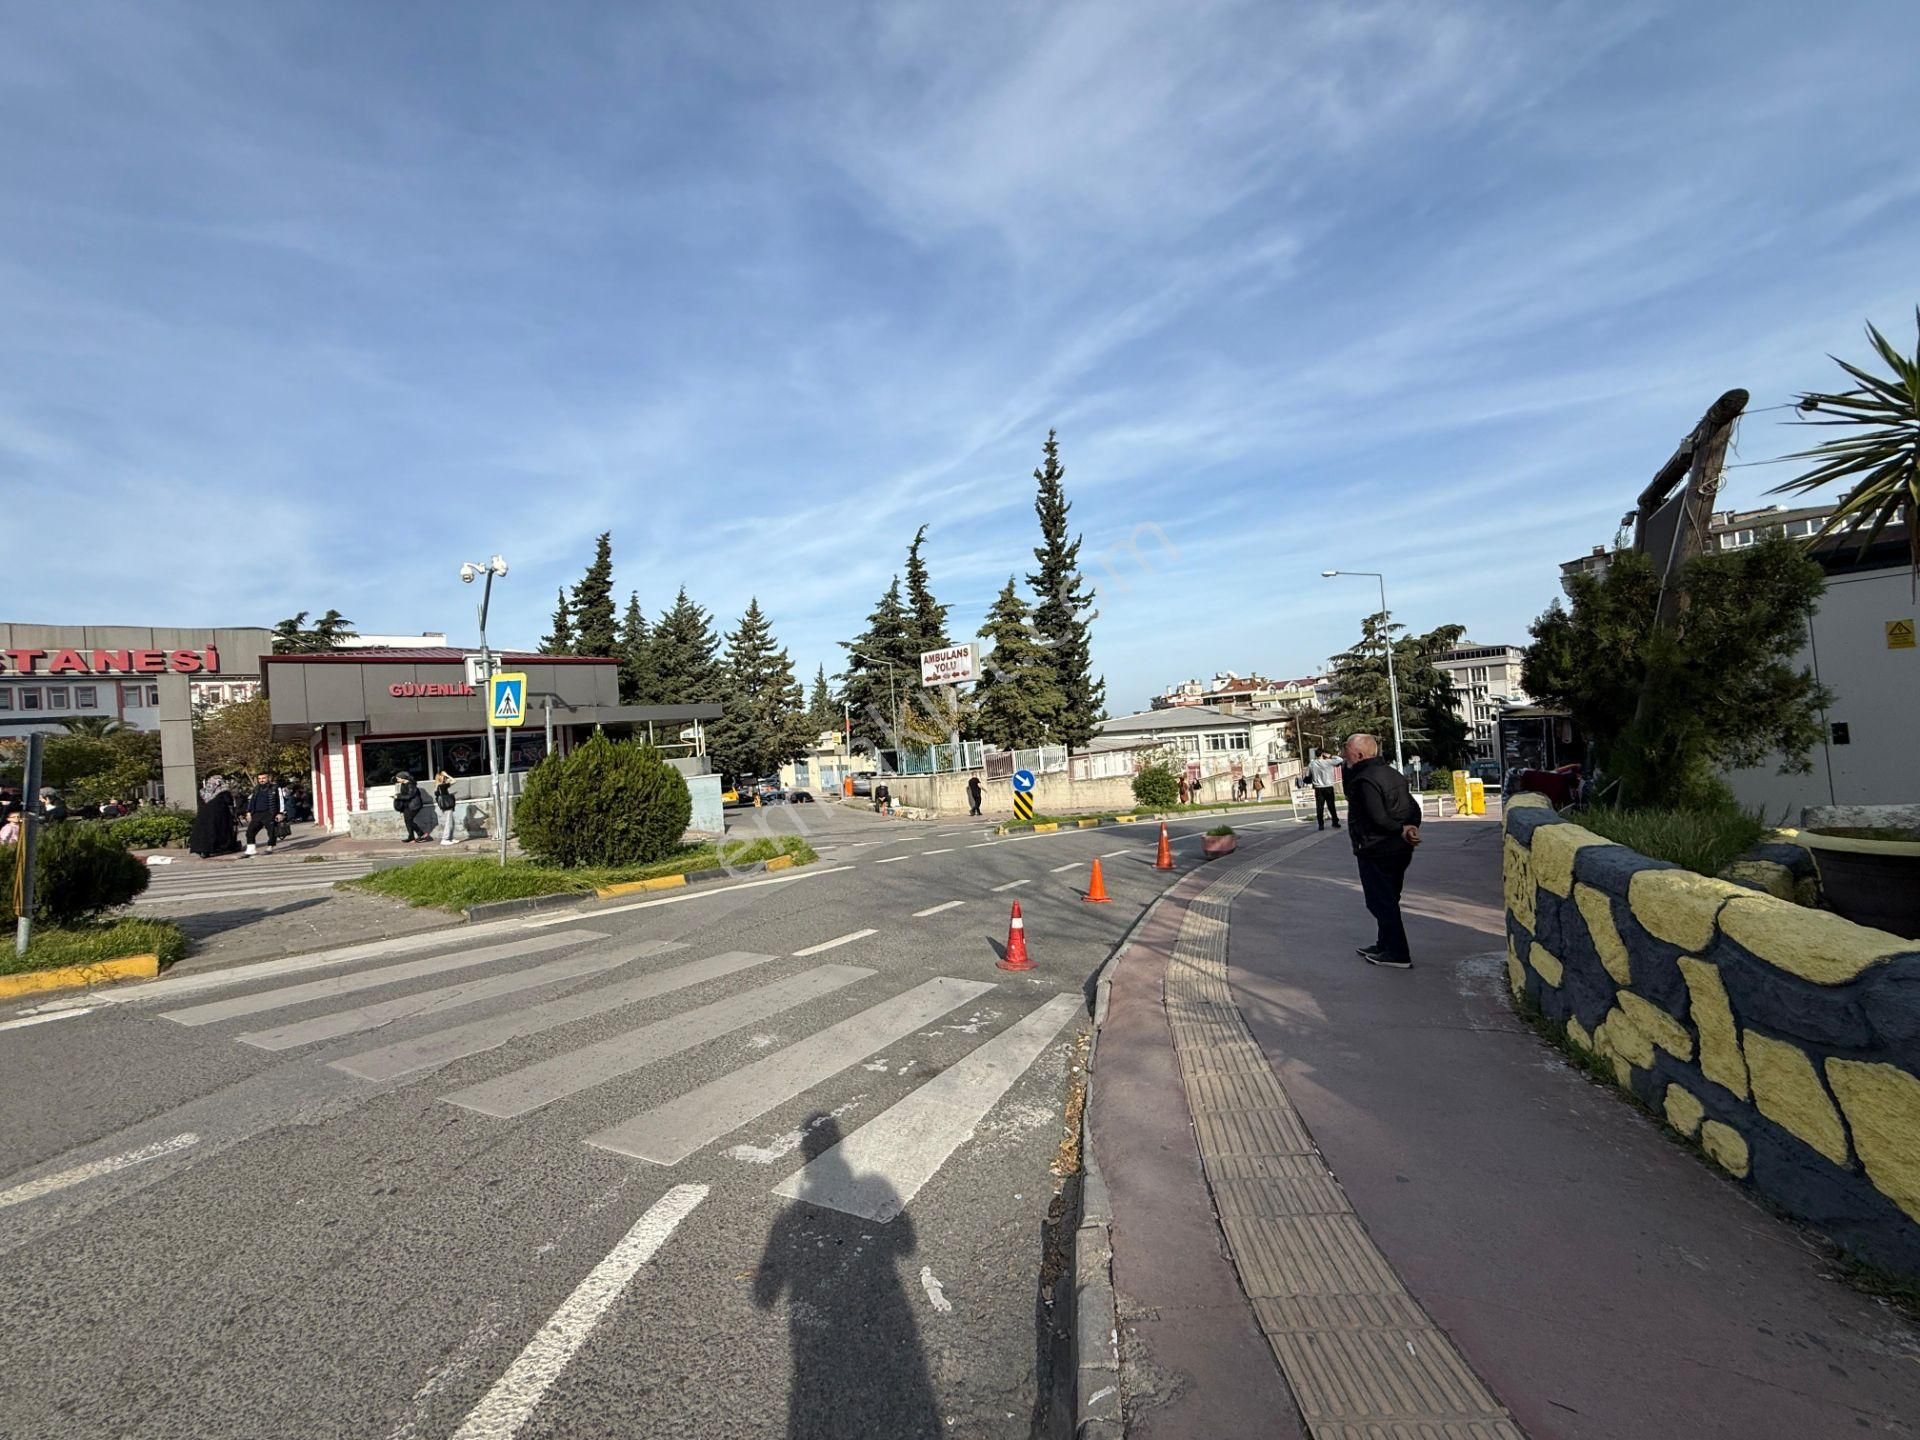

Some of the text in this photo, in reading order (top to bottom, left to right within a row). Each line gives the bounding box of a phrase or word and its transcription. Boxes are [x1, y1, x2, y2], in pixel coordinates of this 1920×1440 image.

[0, 644, 219, 673] TANESİ
[924, 648, 968, 665] AMBULANS
[935, 661, 957, 673] YOLU
